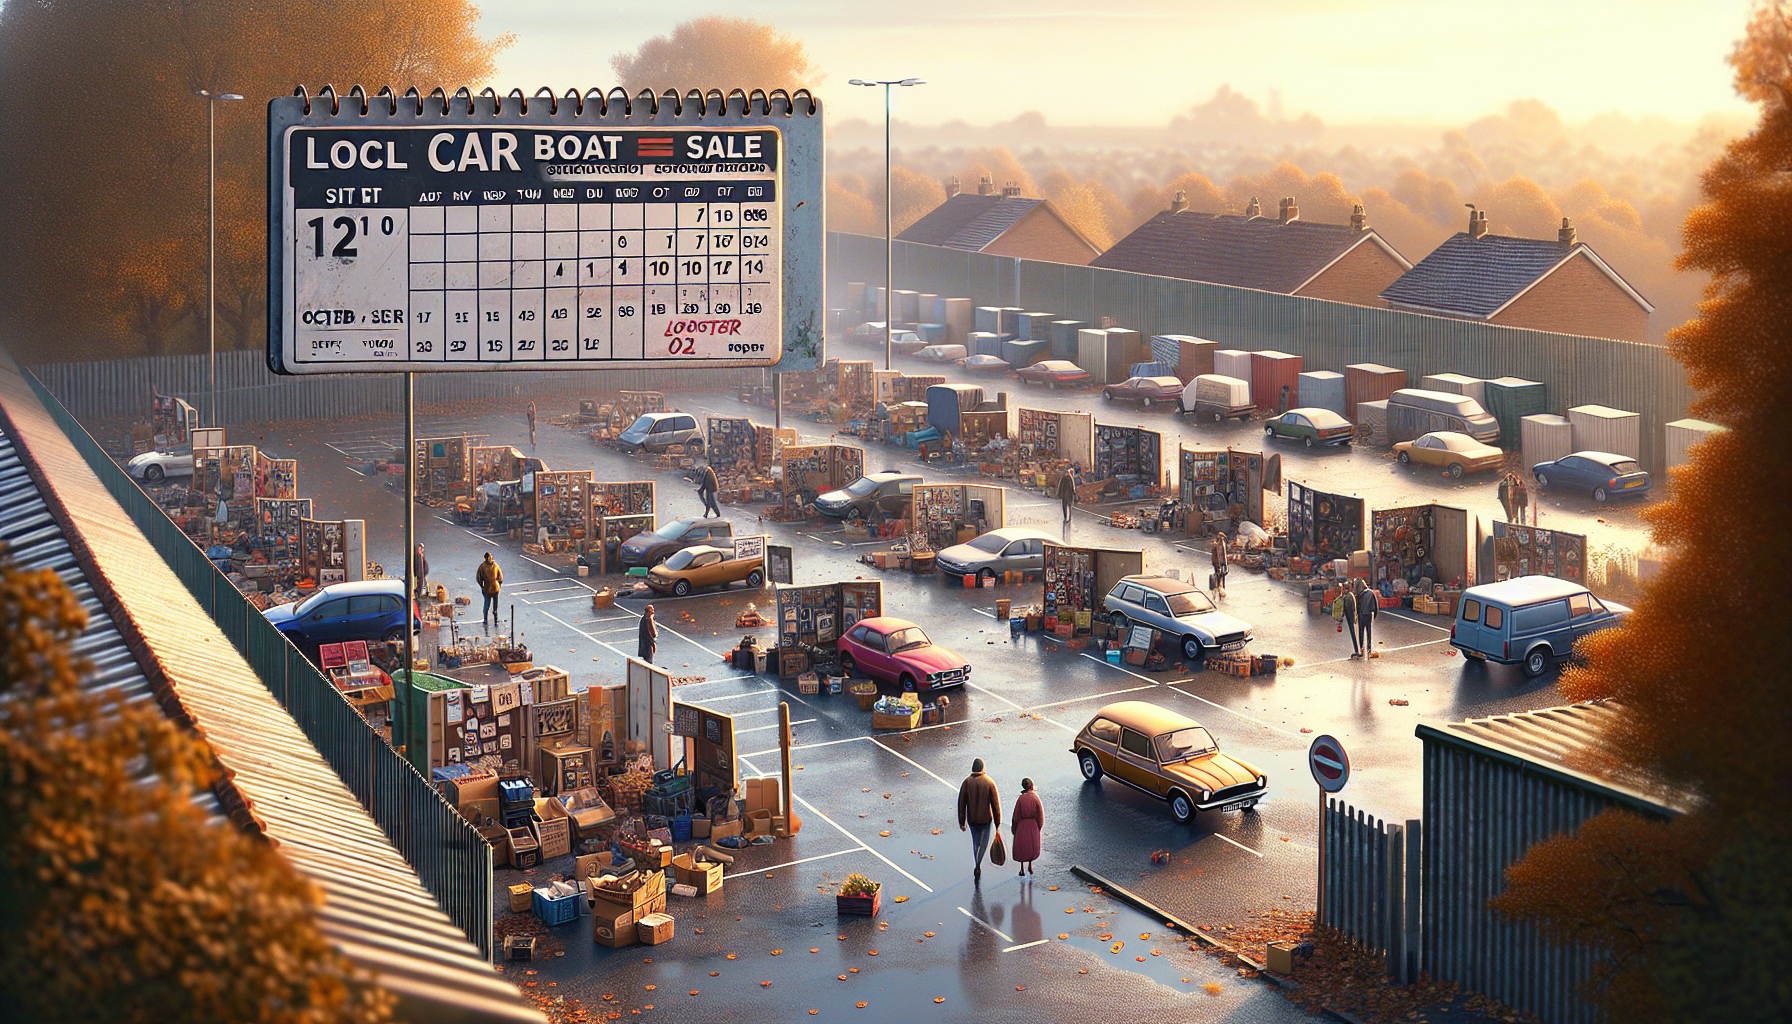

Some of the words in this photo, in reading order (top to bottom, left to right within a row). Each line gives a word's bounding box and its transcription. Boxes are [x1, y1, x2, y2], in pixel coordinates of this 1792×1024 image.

[306, 136, 408, 170] LOCL
[427, 132, 522, 172] CAR
[534, 134, 623, 161] BOAT
[686, 135, 762, 159] SALE
[308, 216, 358, 258] 12
[649, 261, 669, 276] 10
[682, 260, 702, 276] 10
